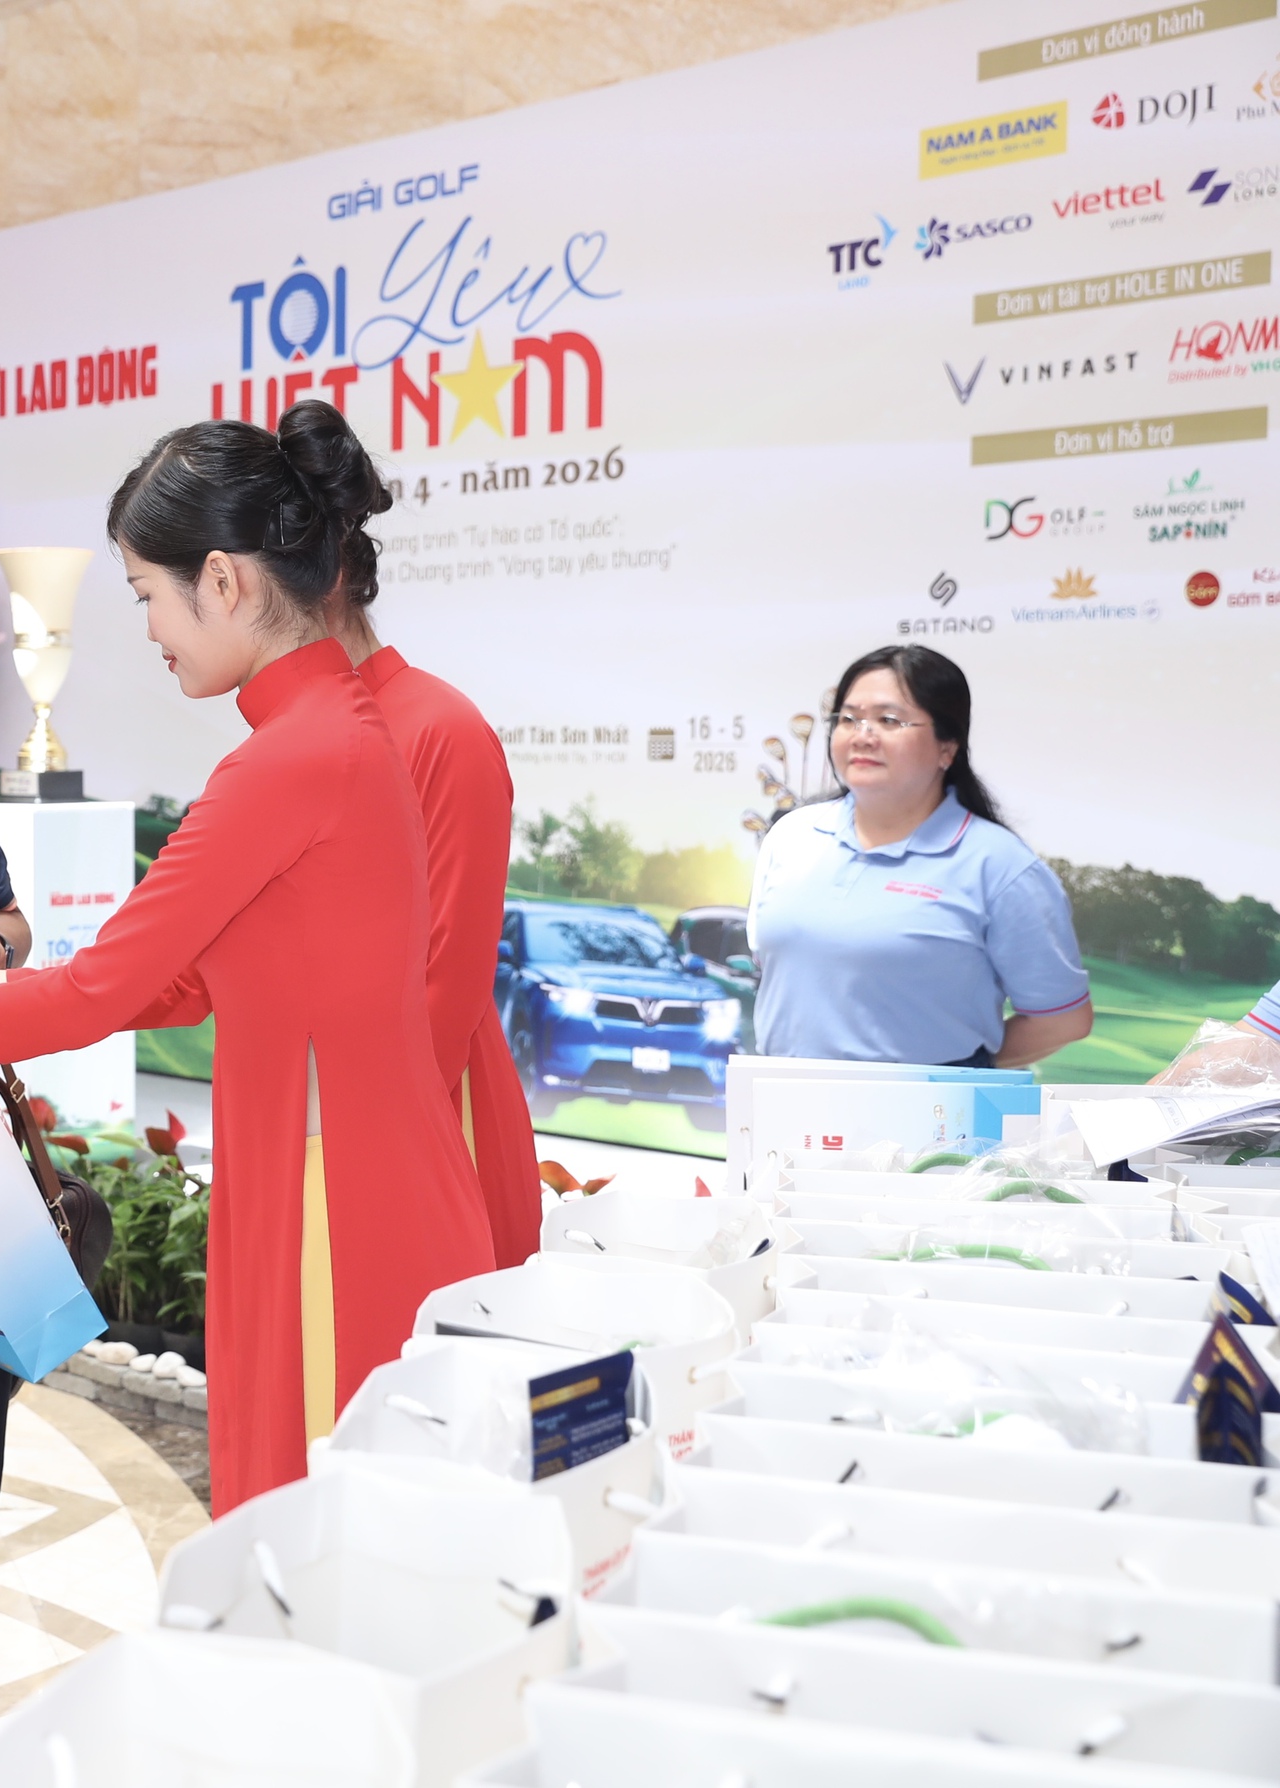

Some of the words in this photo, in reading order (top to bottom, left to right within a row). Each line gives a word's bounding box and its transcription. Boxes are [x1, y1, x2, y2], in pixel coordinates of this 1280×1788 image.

[1042, 37, 1078, 63] Đơn
[1084, 28, 1099, 55] vị
[1105, 19, 1151, 47] đồng
[1157, 6, 1204, 37] hành
[1138, 83, 1217, 126] DOJI
[927, 129, 976, 154] NAM
[979, 126, 993, 143] A
[998, 112, 1058, 139] BANK
[327, 180, 382, 220] GIẢI
[394, 164, 479, 206] GOLF
[1052, 178, 1165, 218] viettel
[956, 213, 1032, 242] SASCO
[828, 238, 882, 273] TTC
[997, 292, 1033, 316] Đơn
[1038, 287, 1053, 313] vị
[1058, 282, 1080, 308] tài
[1085, 280, 1111, 305] trợ
[1115, 269, 1167, 299] HOLE
[1175, 266, 1195, 291] IN
[1201, 258, 1243, 287] ONE
[230, 255, 347, 372] TÔI
[16, 359, 67, 415] LAO
[77, 345, 158, 407] ĐỘNG
[1001, 352, 1139, 386] VINFAST
[1054, 430, 1092, 455] Đơn
[1097, 426, 1113, 453] vị
[1118, 420, 1143, 449] hỗ
[1147, 421, 1174, 449] trợ
[414, 475, 431, 506] 4
[462, 461, 530, 494] năm
[544, 444, 625, 487] 2026
[1211, 498, 1245, 514] LINH
[897, 615, 994, 635] SATANO
[530, 726, 554, 744] Tân
[561, 726, 587, 744] Sơn
[593, 723, 628, 744] Nhất
[687, 715, 711, 741] 16
[732, 715, 745, 741] 5
[693, 751, 737, 773] 2026
[668, 1429, 694, 1447] THÀN
